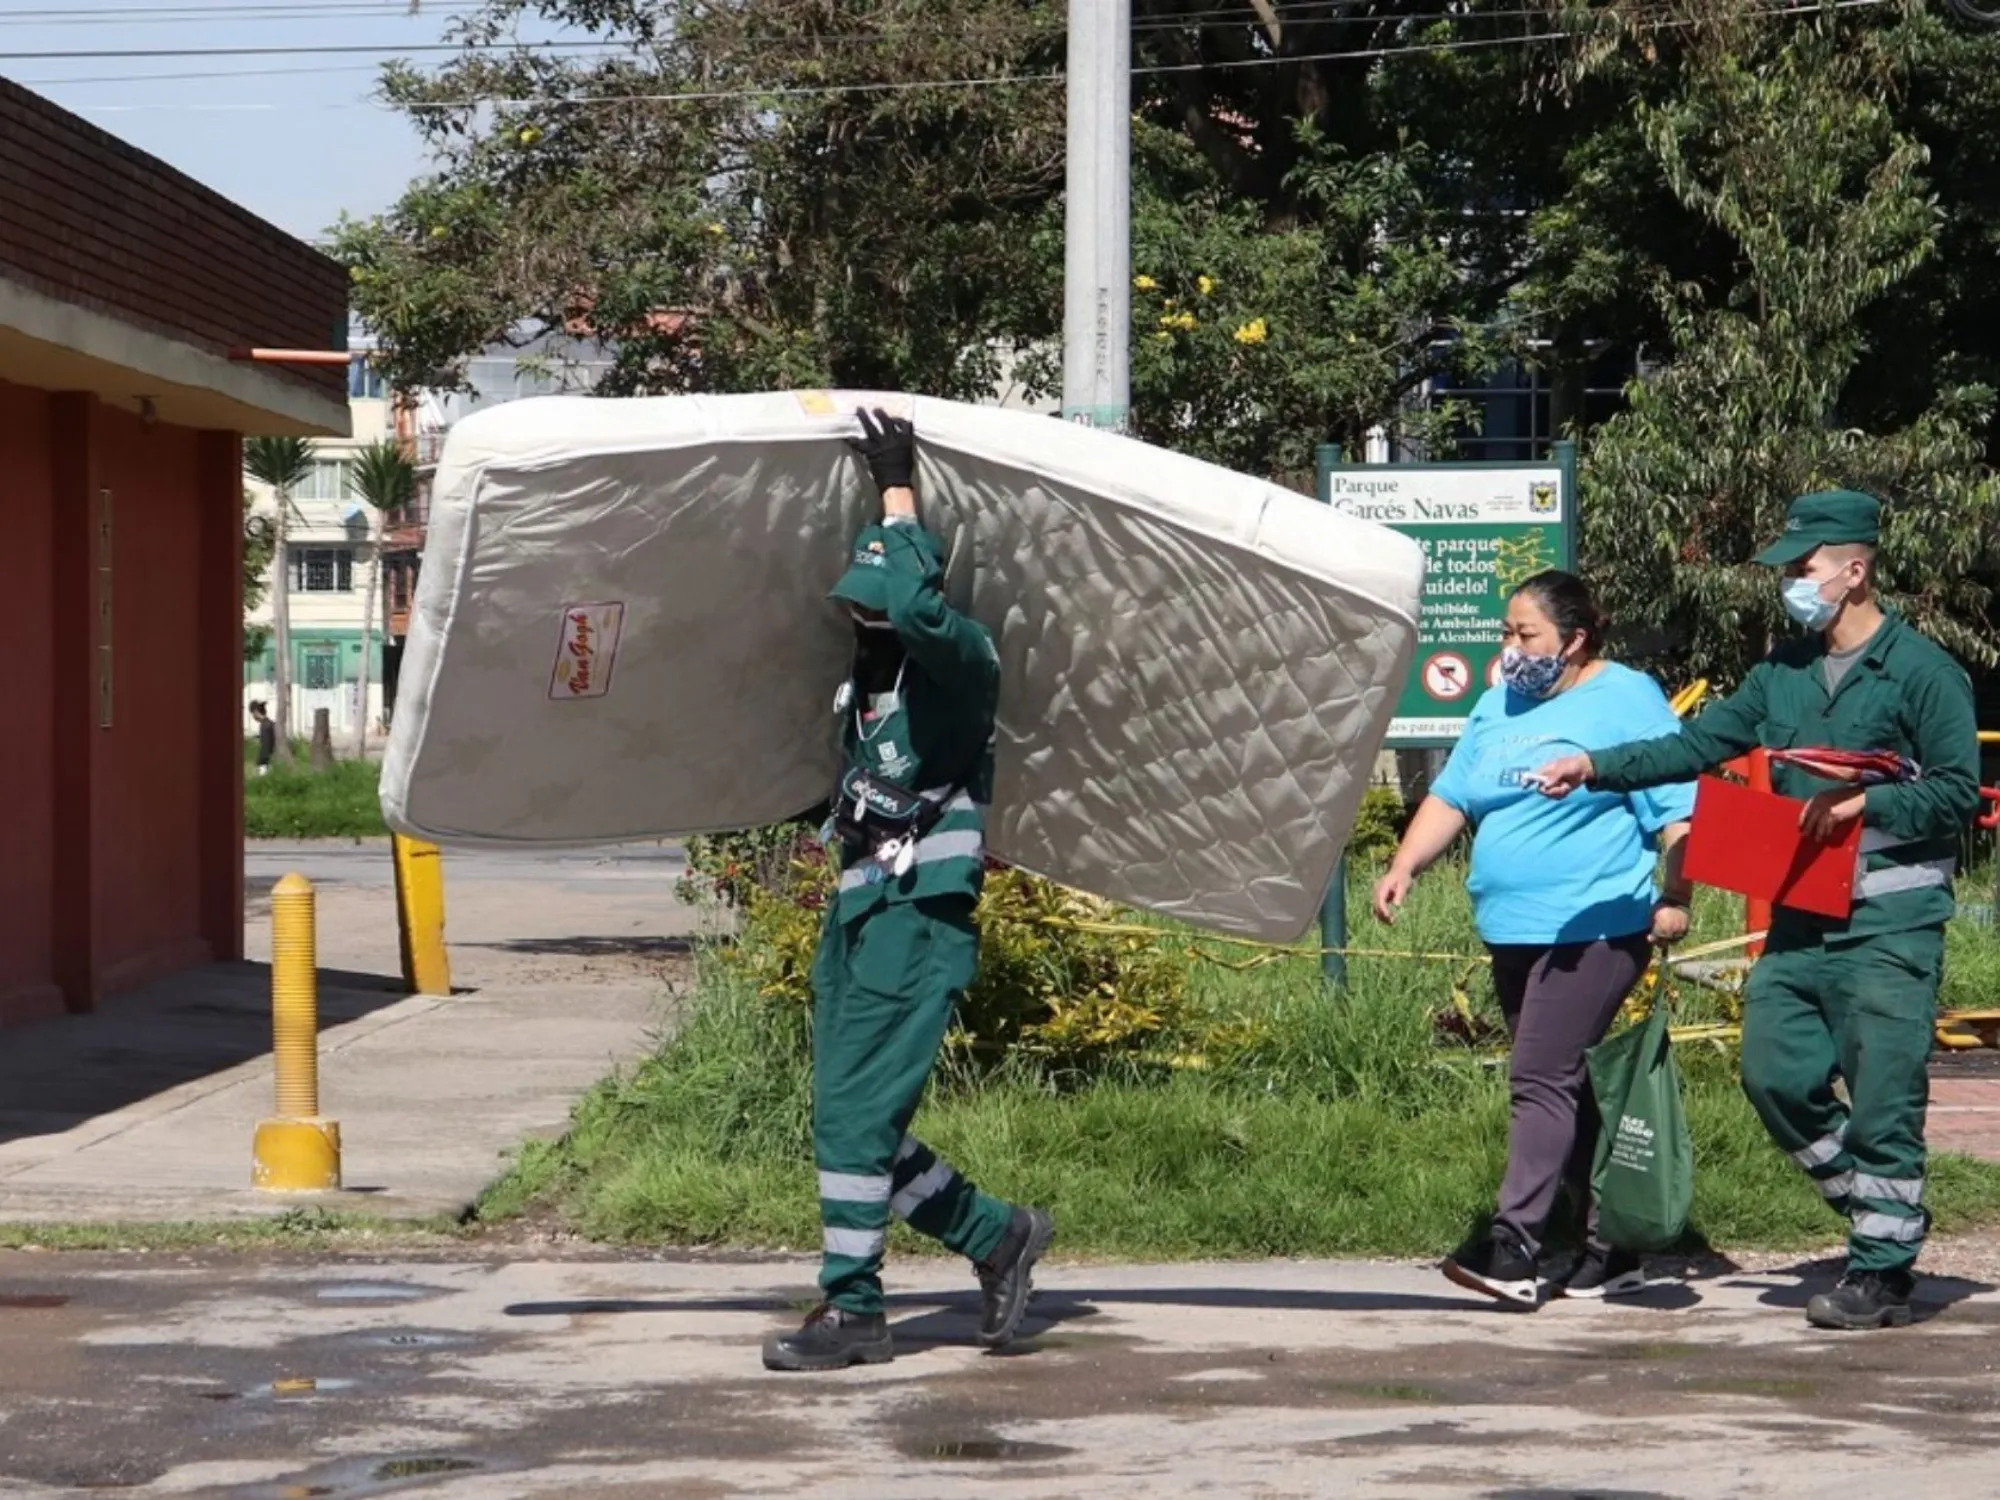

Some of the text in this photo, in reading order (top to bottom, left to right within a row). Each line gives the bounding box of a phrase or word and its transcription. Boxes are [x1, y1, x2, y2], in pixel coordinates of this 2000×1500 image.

[1334, 478, 1399, 498] Parque
[1412, 497, 1479, 519] Navas
[1436, 538, 1498, 561] parque
[1447, 557, 1496, 573] todos
[1420, 602, 1480, 615] rohibido:
[1433, 616, 1503, 629] Ambulante
[1437, 631, 1504, 643] Alcohólica
[567, 614, 595, 694] Van Gogh
